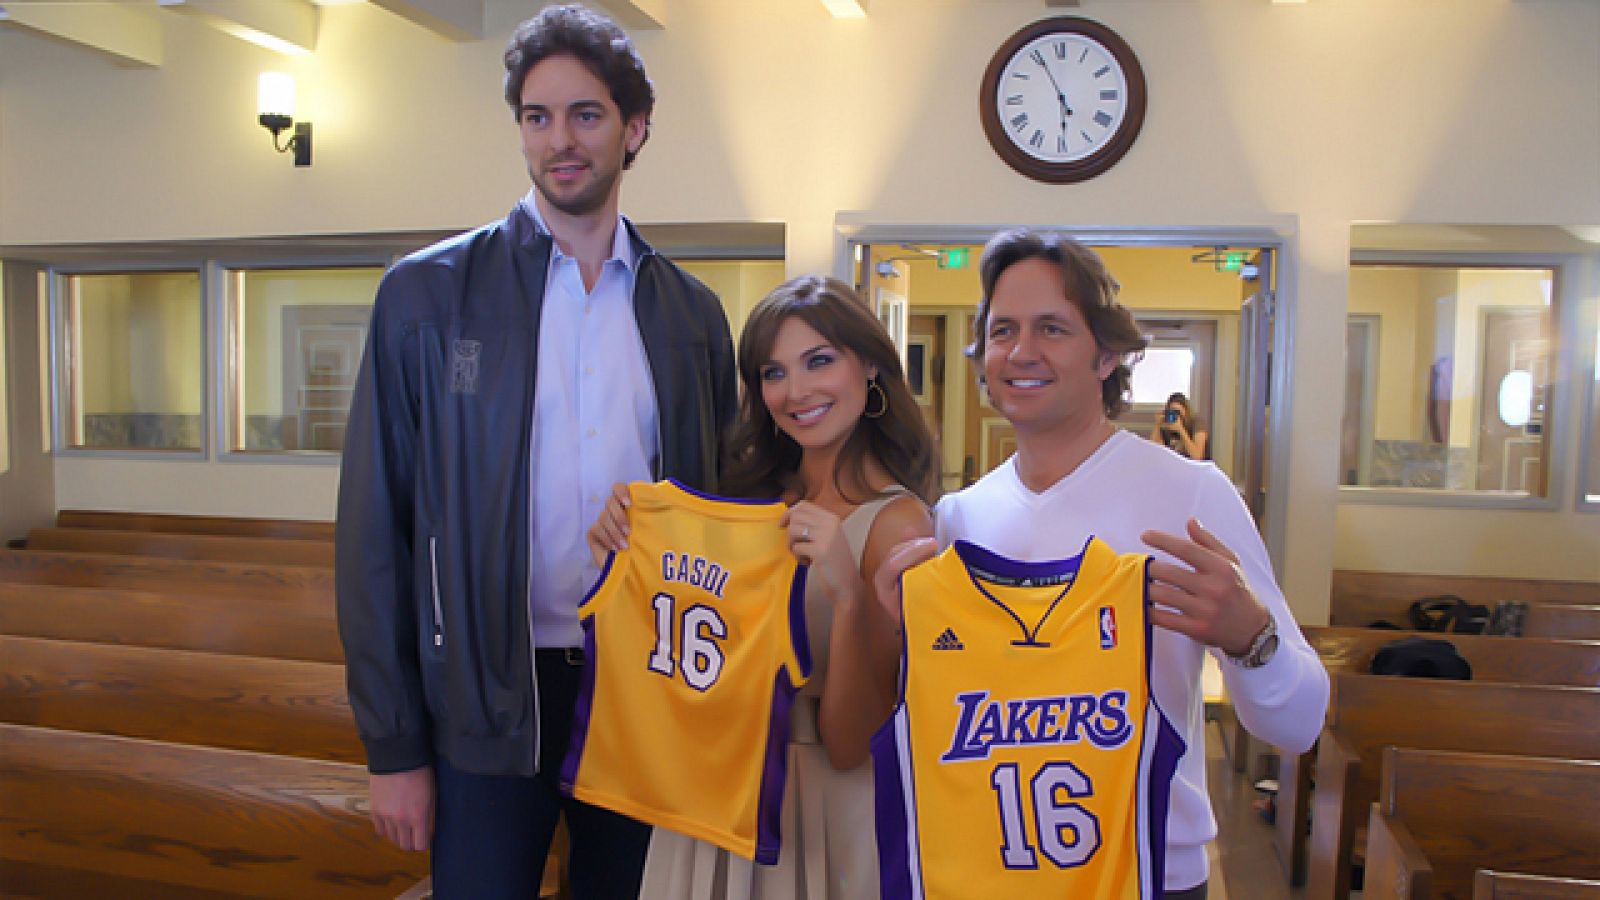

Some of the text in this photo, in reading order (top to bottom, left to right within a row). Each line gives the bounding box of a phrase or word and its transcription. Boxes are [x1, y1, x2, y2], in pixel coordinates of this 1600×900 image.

[661, 551, 730, 599] GASOL
[647, 591, 728, 692] 16
[940, 689, 1135, 763] LAKERS
[991, 761, 1102, 870] 16
